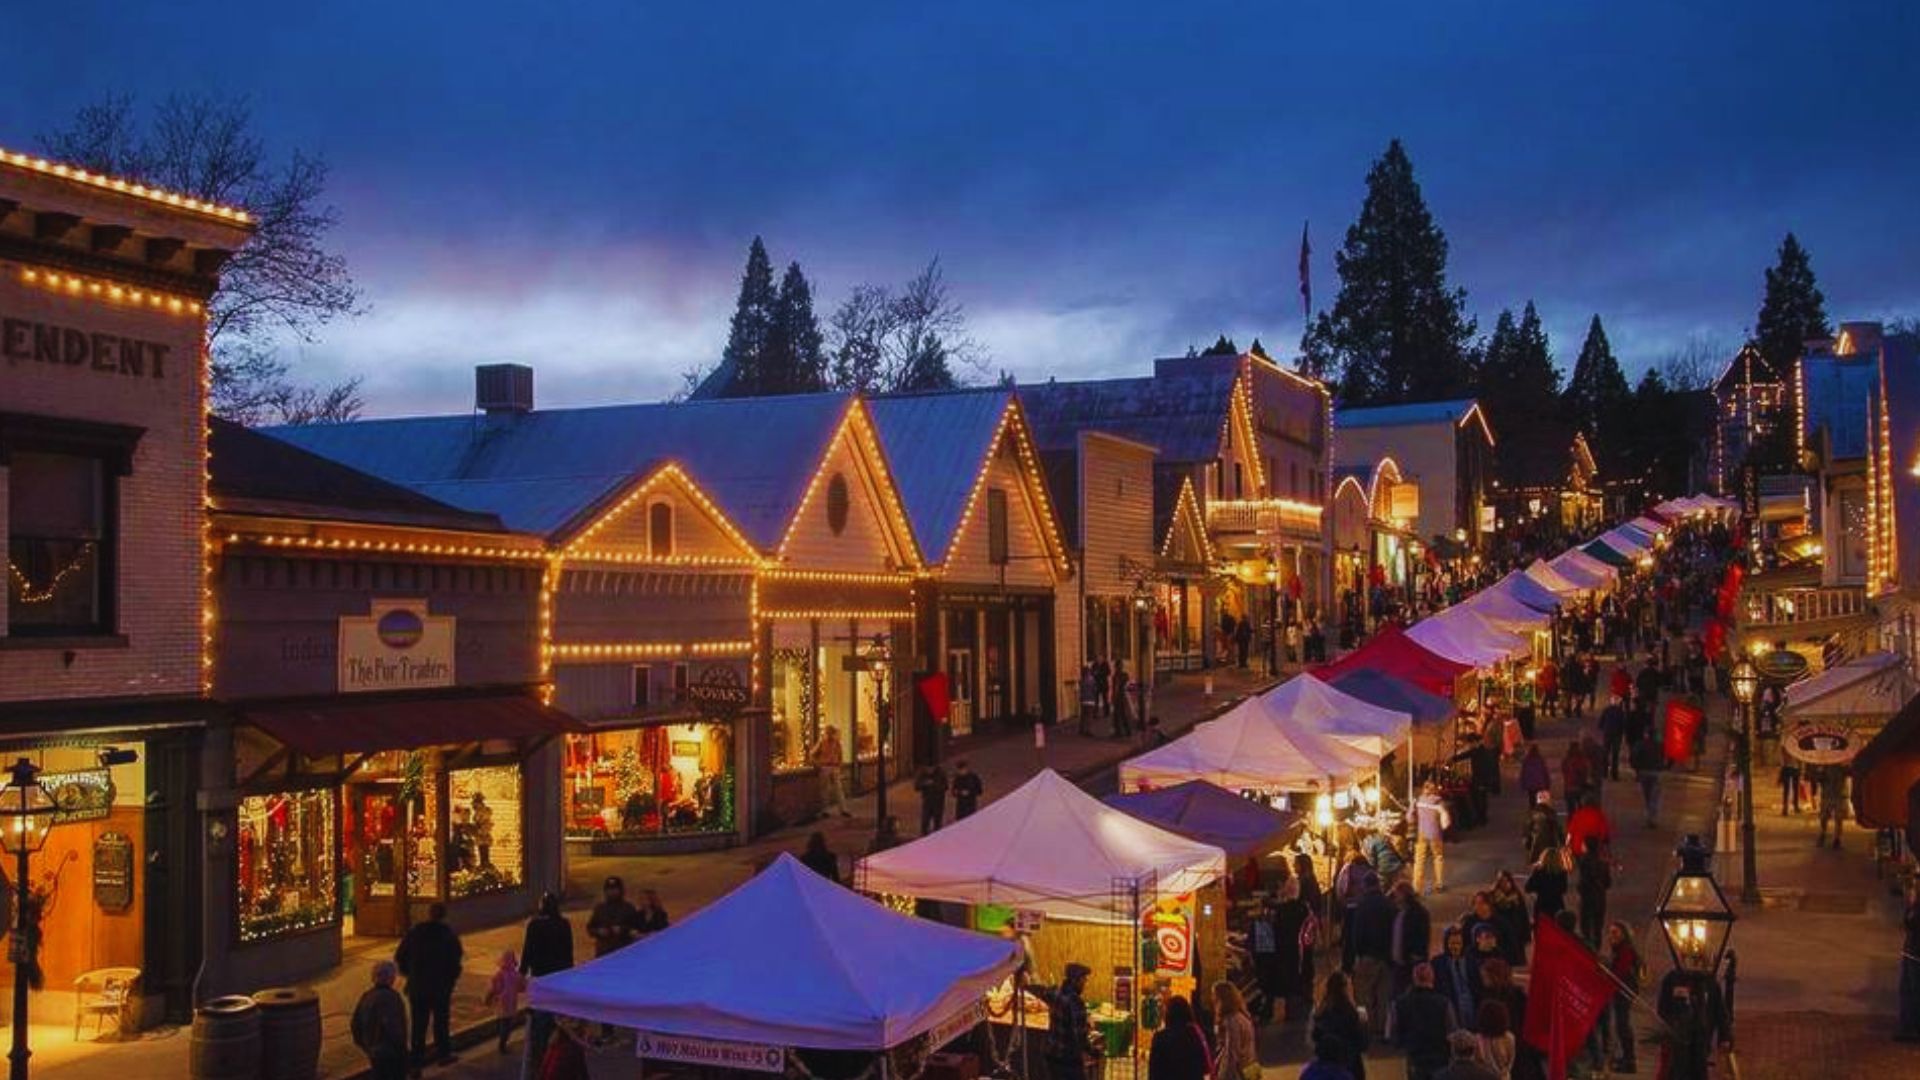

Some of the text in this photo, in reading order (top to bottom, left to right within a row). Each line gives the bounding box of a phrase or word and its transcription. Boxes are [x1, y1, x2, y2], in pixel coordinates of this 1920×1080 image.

[2, 318, 171, 379] ENDENT
[346, 655, 449, 684] The Fur Traders
